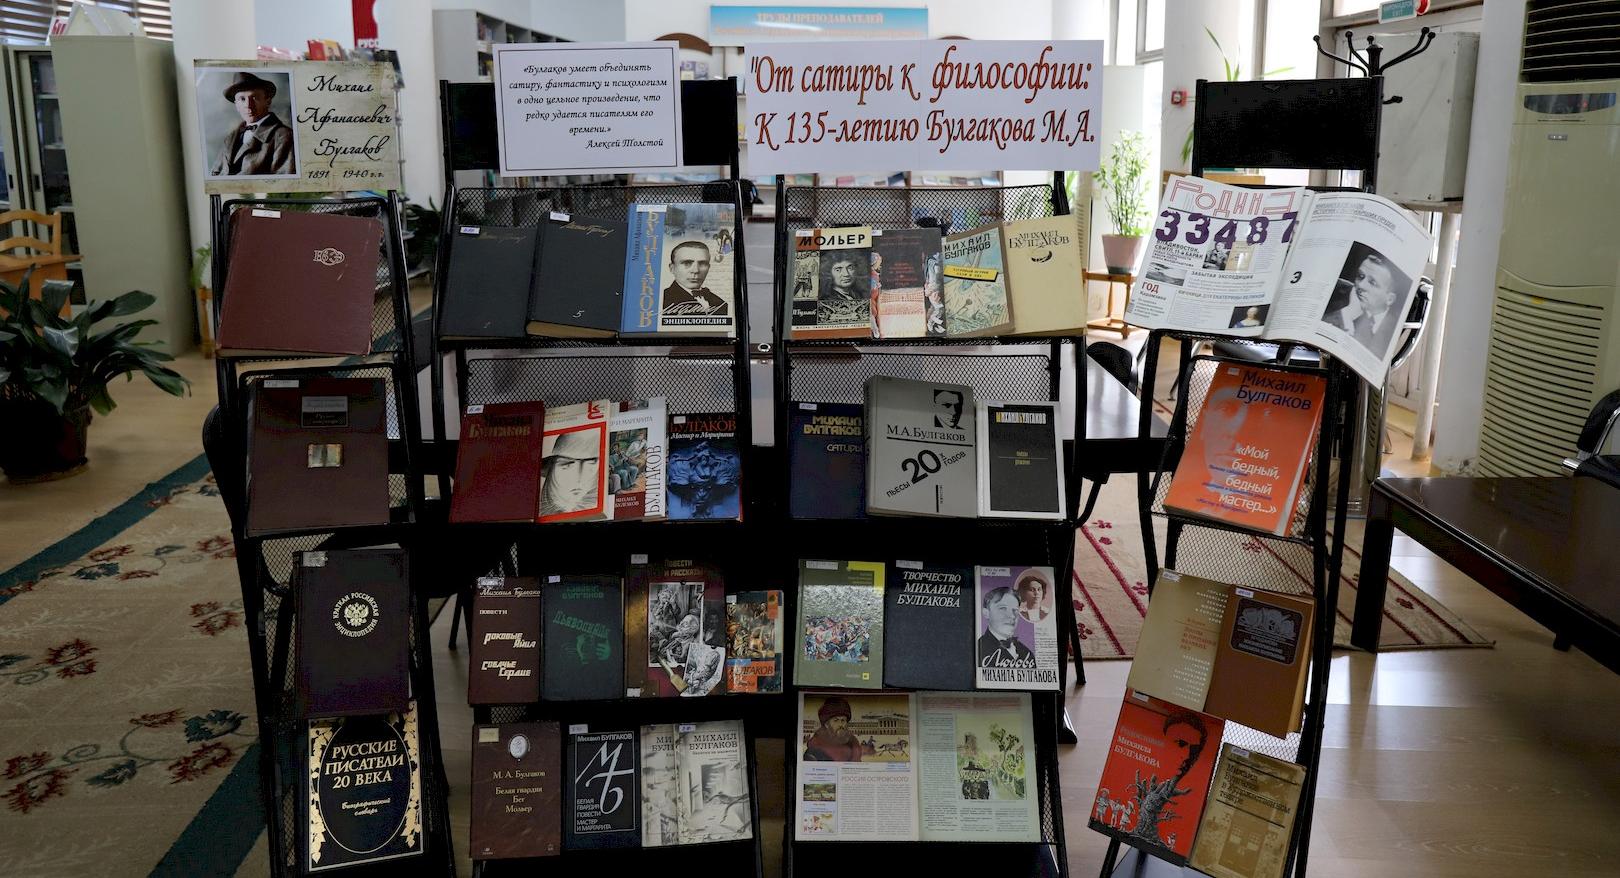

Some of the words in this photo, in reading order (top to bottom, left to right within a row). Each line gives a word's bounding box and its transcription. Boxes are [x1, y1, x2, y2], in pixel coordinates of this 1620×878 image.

[523, 65, 567, 76] «Булгаков
[568, 65, 597, 75] умеет
[599, 62, 652, 72] объединять
[801, 62, 893, 104] сатиры
[901, 60, 921, 101] к
[930, 46, 1093, 103] философии:
[308, 75, 374, 92] Михаил
[509, 81, 543, 92] сатиру,
[545, 79, 602, 91] фантастику
[612, 79, 667, 89] психологизм
[523, 96, 544, 105] одно
[546, 97, 580, 106] цельное
[582, 94, 641, 105] произведение,
[297, 104, 392, 131] Афанасьевич
[526, 111, 550, 122] редко
[551, 111, 587, 121] удается
[589, 110, 637, 118] писателям
[640, 110, 653, 119] его
[569, 126, 611, 136] времени.»
[755, 113, 780, 151] К
[785, 110, 920, 145] 135-летию
[926, 110, 1036, 154] Булгакова
[1041, 109, 1095, 147] М.А.
[585, 139, 620, 149] Алексей
[622, 139, 664, 148] Толстой
[314, 135, 389, 168] Булгаков
[308, 169, 330, 179] 1891
[343, 169, 368, 178] 1940
[799, 234, 866, 246] МОЛЬЕР
[944, 233, 990, 252] МИХАИЛ
[944, 241, 991, 260] БУЛГАКОВ
[1141, 281, 1160, 294] ГОД
[1241, 371, 1306, 393] Михаил
[1236, 384, 1312, 410] Булгаков
[1237, 445, 1270, 461] «Мой
[1232, 458, 1280, 480] бедный,
[645, 445, 661, 514] БУЛГАКОВ
[1226, 476, 1272, 495] бедный
[886, 481, 911, 498] ПЬЕСЫ
[903, 571, 962, 583] ТВОРЧЕСТВО
[904, 582, 962, 596] МИХАИЛА
[897, 594, 960, 608] БУЛГАКОВА
[982, 648, 1036, 668] Любовь
[982, 669, 1014, 681] МИХАИЛА
[1017, 670, 1057, 683] БУЛГАКОВА
[601, 733, 633, 741] БУЛГАКОВ
[693, 733, 737, 742] МИХАИЛ
[332, 740, 397, 760] РУССКИЕ
[689, 741, 738, 751] БУЛГАКОВ
[324, 754, 405, 775] ПИСАТЕЛИ
[332, 776, 351, 790] 20
[354, 770, 393, 787] ВЕКА
[515, 770, 546, 780] Булгаков
[495, 786, 516, 796] Белая
[516, 787, 543, 797] гвардия
[512, 795, 526, 804] Бег
[505, 804, 533, 814] Мольер
